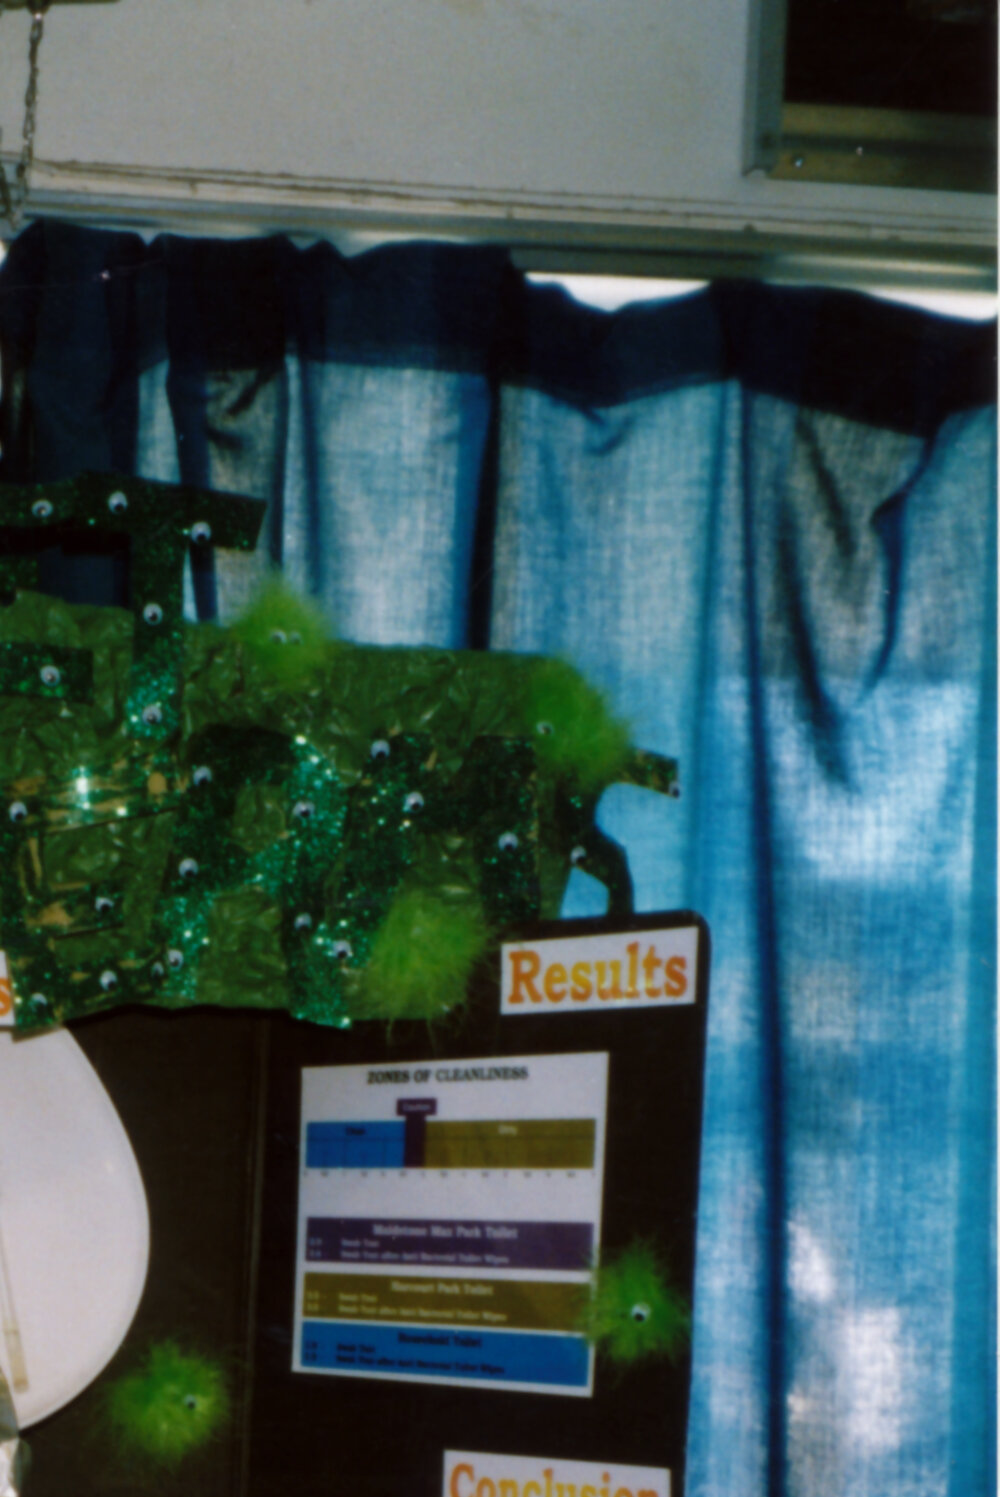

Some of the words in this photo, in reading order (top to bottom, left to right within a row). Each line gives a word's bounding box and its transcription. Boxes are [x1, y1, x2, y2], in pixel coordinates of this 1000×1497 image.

[507, 940, 688, 1004] Results
[367, 1069, 410, 1085] ZONES
[413, 1069, 432, 1084] OF
[435, 1066, 529, 1083] CLEANLINESS
